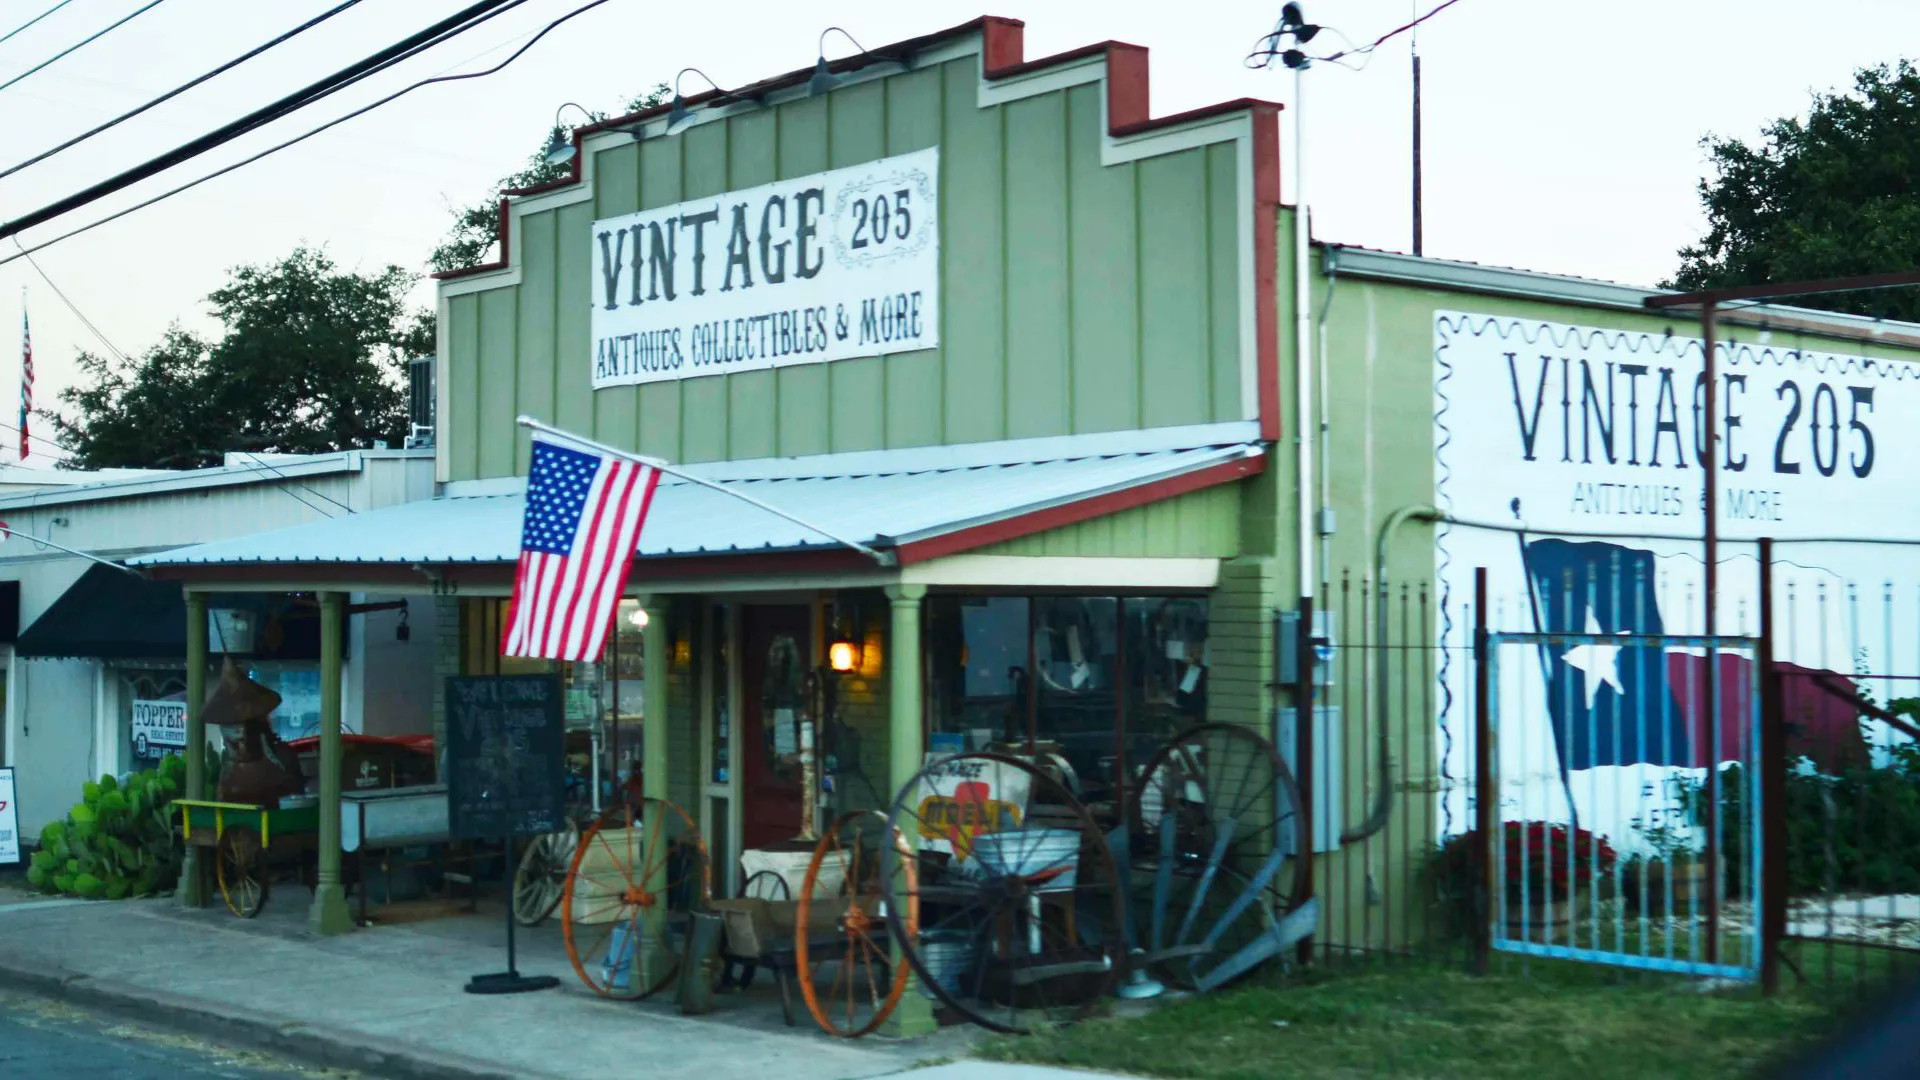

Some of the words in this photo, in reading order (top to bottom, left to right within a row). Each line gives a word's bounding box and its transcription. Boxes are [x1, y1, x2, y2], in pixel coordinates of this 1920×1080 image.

[597, 187, 825, 311] VINTAGE
[851, 189, 911, 249] 205
[691, 305, 827, 367] COLLECTIBLES
[835, 302, 849, 341] &
[858, 290, 922, 346] MORE
[1503, 351, 1747, 472] VINTAGE
[1773, 379, 1875, 478] 205
[1570, 481, 1683, 516] ANTIQUES
[1726, 488, 1783, 522] MORE
[134, 703, 186, 729] TOPPER
